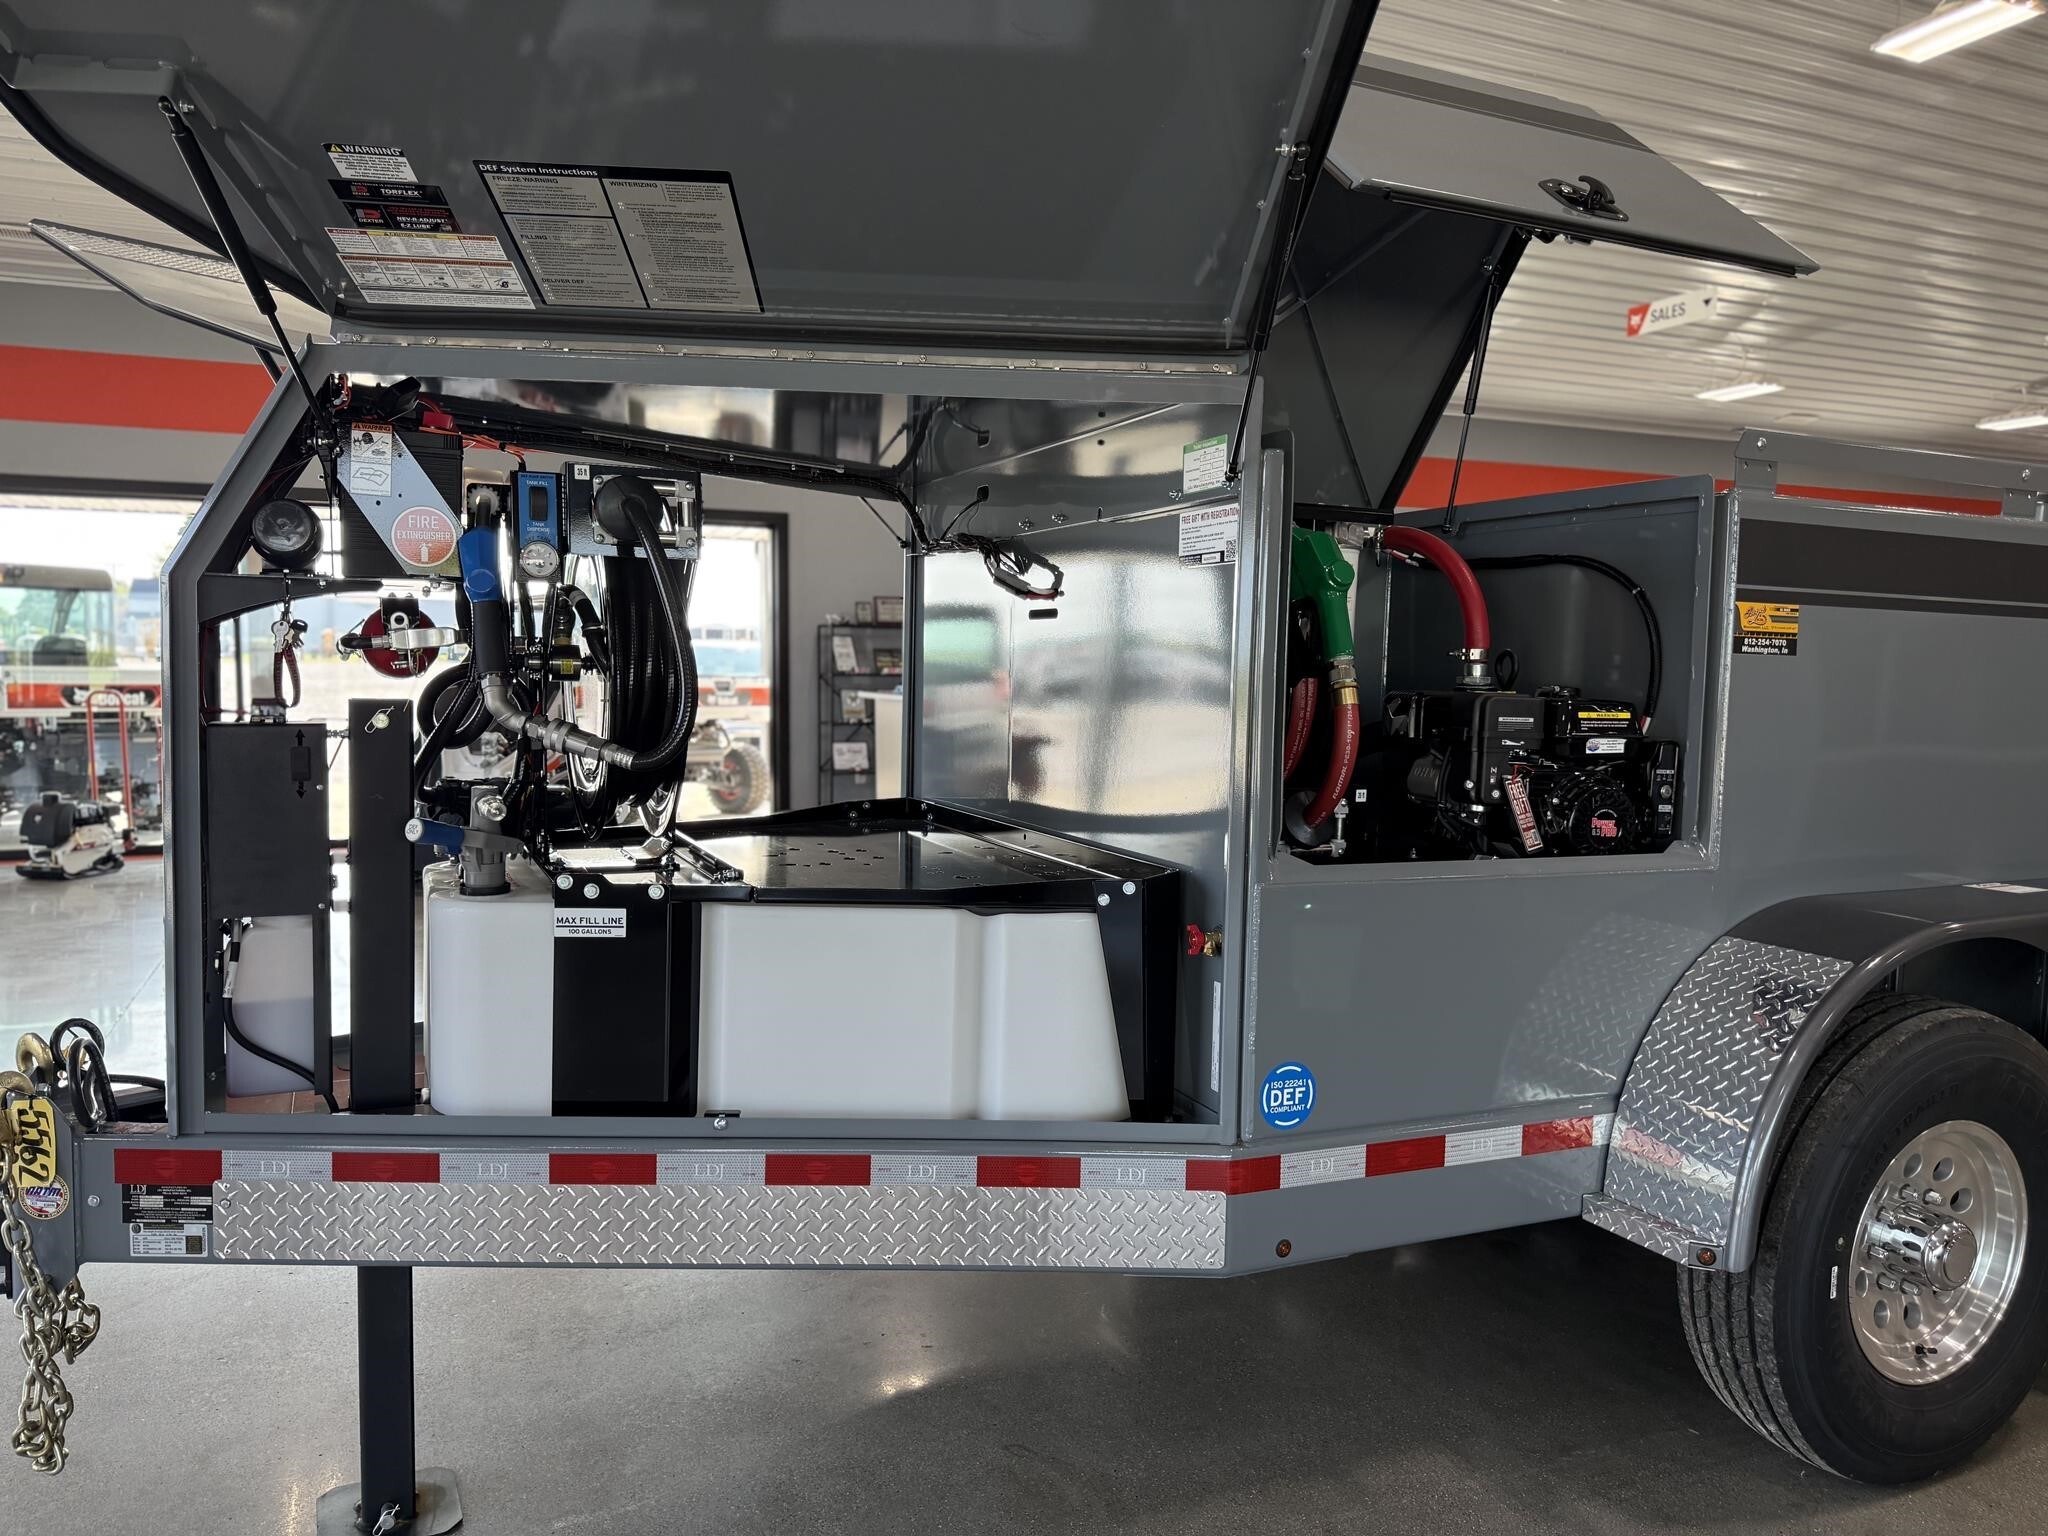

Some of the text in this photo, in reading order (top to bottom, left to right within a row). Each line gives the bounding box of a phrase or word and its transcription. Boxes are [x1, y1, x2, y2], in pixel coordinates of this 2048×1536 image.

[341, 145, 402, 156] WARNING
[478, 164, 598, 176] DEF System Instructions
[1650, 302, 1686, 323] SALES
[576, 467, 584, 476] 35
[408, 515, 439, 529] FIRE
[1181, 514, 1191, 525] FREE
[1191, 513, 1200, 523] GIFT
[1200, 511, 1210, 521] WITH
[397, 531, 452, 542] EXTINGUISHER
[1741, 645, 1780, 654] Washington,
[1508, 782, 1525, 799] FREE
[1513, 797, 1529, 815] GIFT
[1591, 826, 1618, 837] 6.5 PRO
[1270, 1078, 1307, 1089] ISO 22241
[1270, 1087, 1306, 1107] DEF
[1269, 1104, 1306, 1114] COMPLIANT
[17, 1107, 52, 1186] 5562
[260, 1160, 291, 1177] LDJ
[477, 1163, 509, 1179] LDJ
[693, 1164, 725, 1181] LDJ
[907, 1165, 938, 1182] LDJ
[1310, 1158, 1335, 1174] LDJ
[1117, 1168, 1147, 1185] LDJ
[130, 1184, 147, 1195] LDJ
